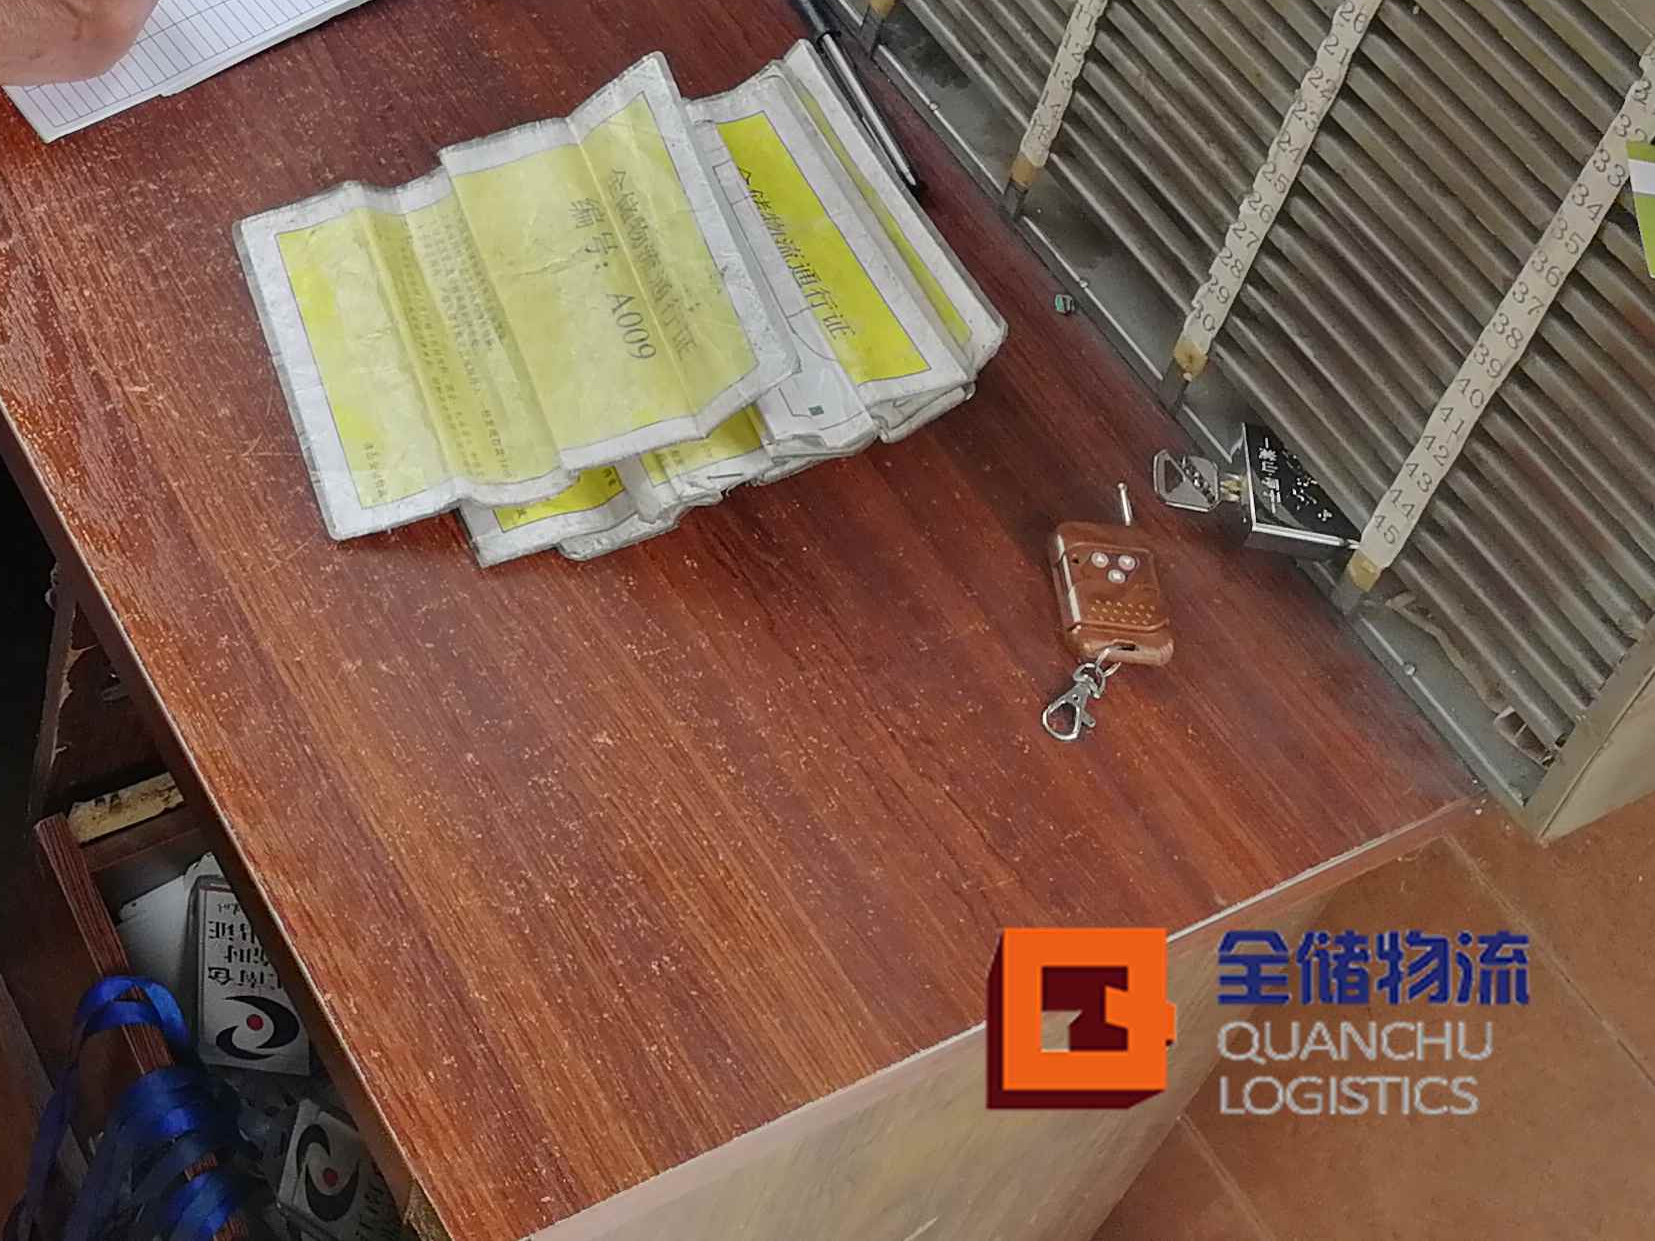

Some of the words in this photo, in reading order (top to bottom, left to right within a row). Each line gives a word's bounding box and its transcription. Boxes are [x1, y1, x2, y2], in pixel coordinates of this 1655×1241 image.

[1323, 35, 1352, 66] 21
[1308, 67, 1338, 102] 22
[1260, 162, 1290, 194] 25
[1593, 147, 1627, 188] 33
[1246, 191, 1275, 224] 26
[1571, 183, 1604, 223] 34
[1231, 220, 1260, 250] 27
[1550, 216, 1587, 256] 35
[1219, 247, 1244, 279] 28
[1531, 249, 1565, 289] 36
[1512, 281, 1547, 316] 37
[604, 291, 657, 363] A009
[1494, 312, 1525, 351] 38
[1473, 342, 1508, 380] 39
[1455, 377, 1486, 410] 40
[1439, 406, 1466, 438] 41
[1423, 434, 1451, 467] 42
[1405, 461, 1433, 494] 43
[1389, 488, 1417, 521] 44
[1373, 513, 1401, 546] 45
